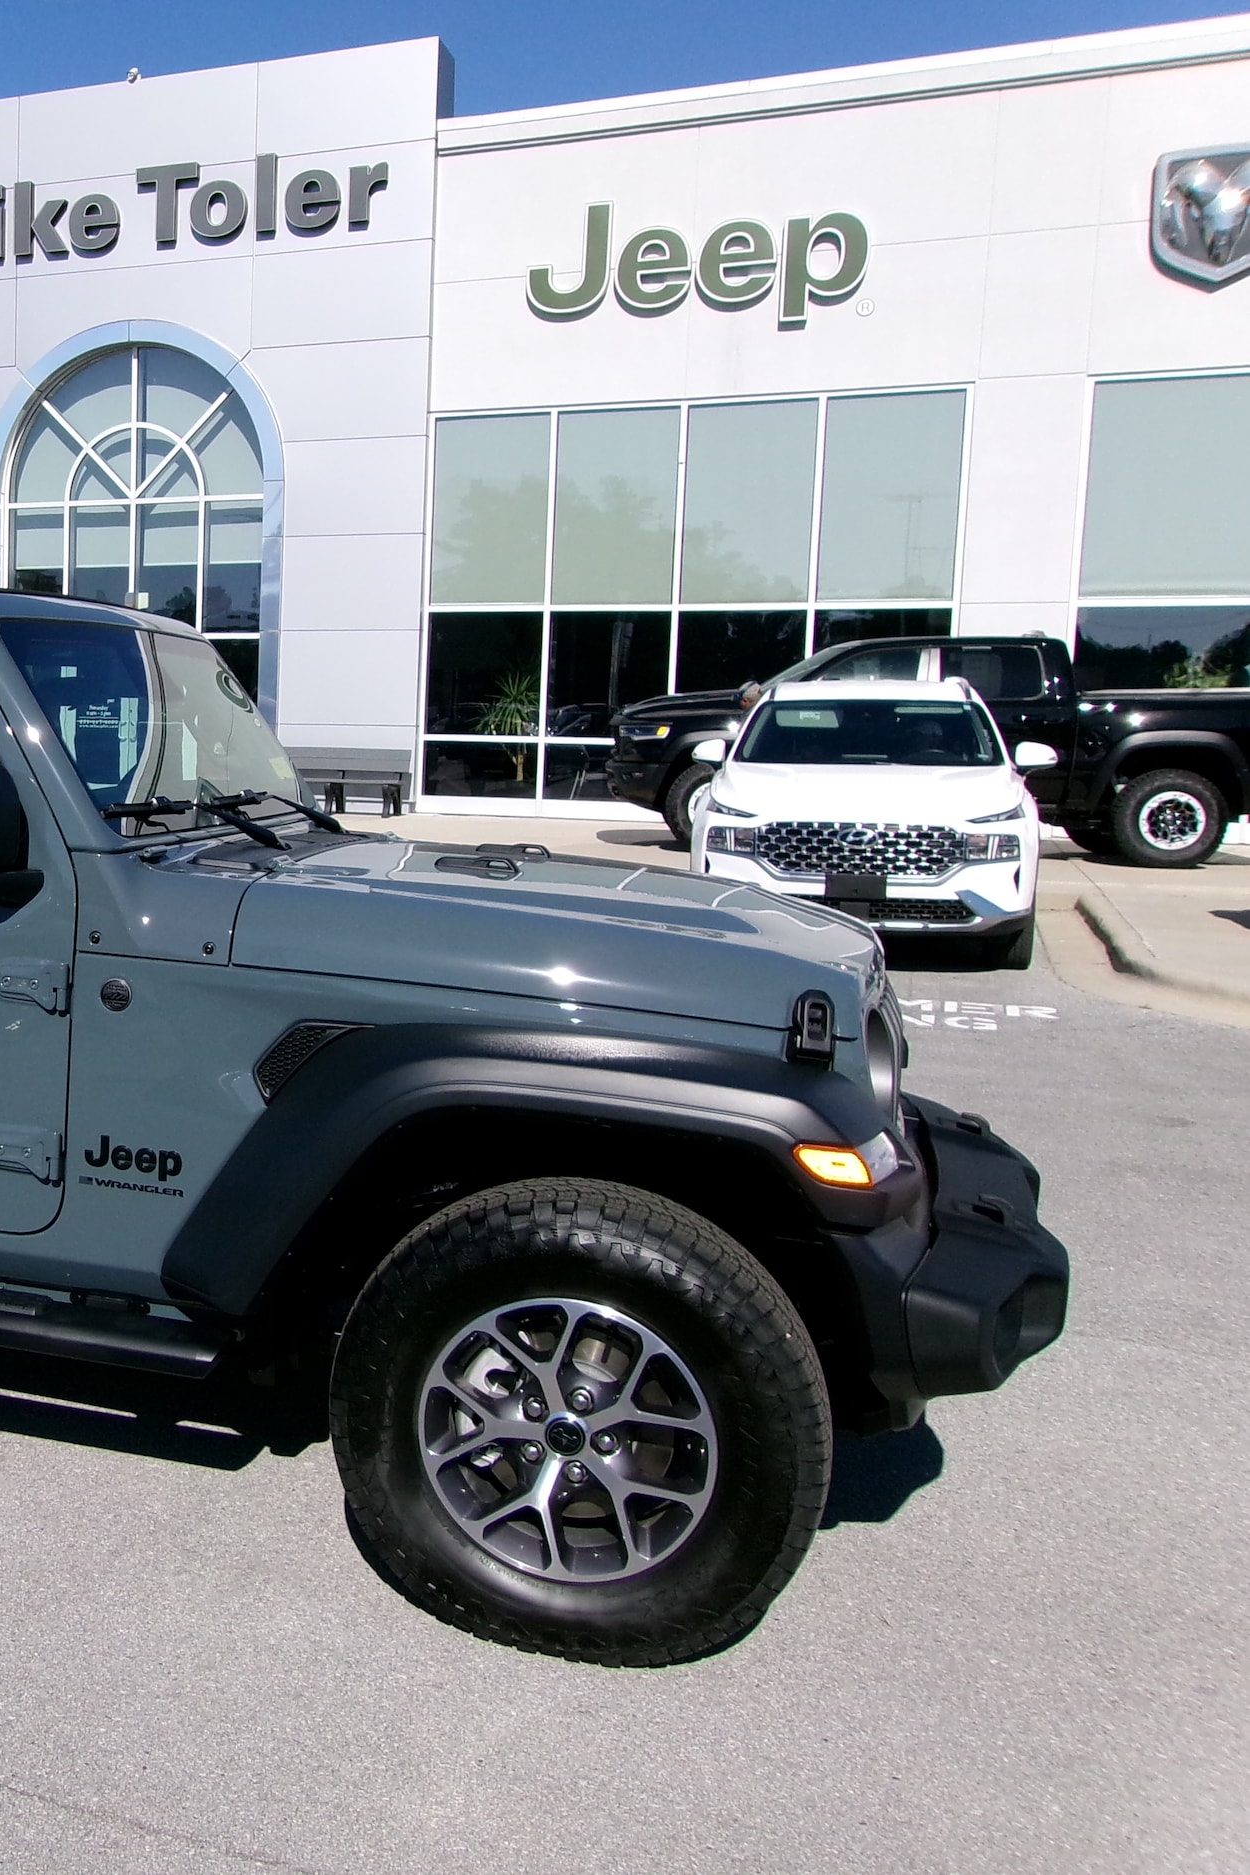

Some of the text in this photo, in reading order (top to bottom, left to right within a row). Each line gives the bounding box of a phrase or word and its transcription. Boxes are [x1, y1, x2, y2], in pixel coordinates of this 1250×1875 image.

[136, 153, 389, 251] Toler
[526, 200, 872, 332] Jeep
[84, 1134, 183, 1182] Jeep
[94, 1177, 185, 1198] WRANGLER
